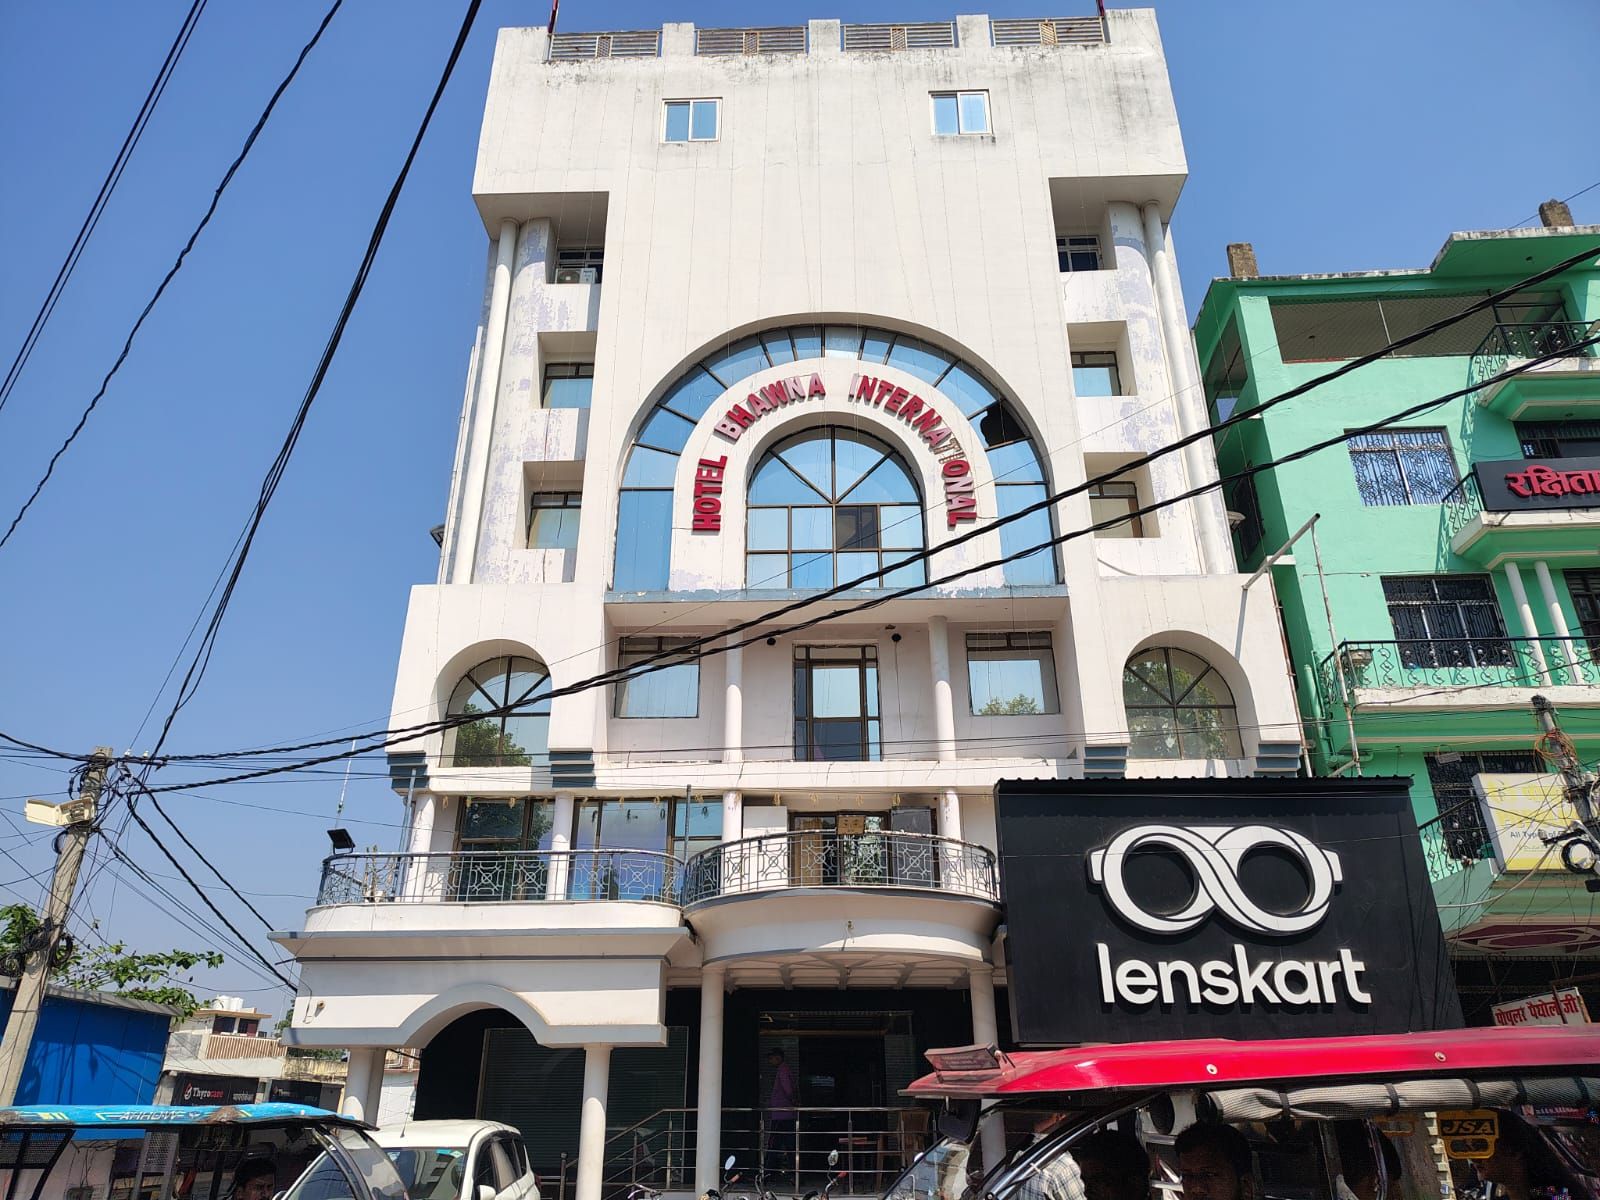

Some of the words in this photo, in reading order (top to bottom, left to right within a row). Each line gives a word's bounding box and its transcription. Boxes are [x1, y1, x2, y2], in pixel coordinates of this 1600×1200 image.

[692, 455, 728, 531] HOTEL
[713, 372, 826, 443] BHAWNA
[848, 372, 978, 530] INTERNATIONAL
[1096, 943, 1372, 1005] lenskart
[193, 1087, 224, 1100] Thyrocare
[1442, 1120, 1494, 1135] JSA
